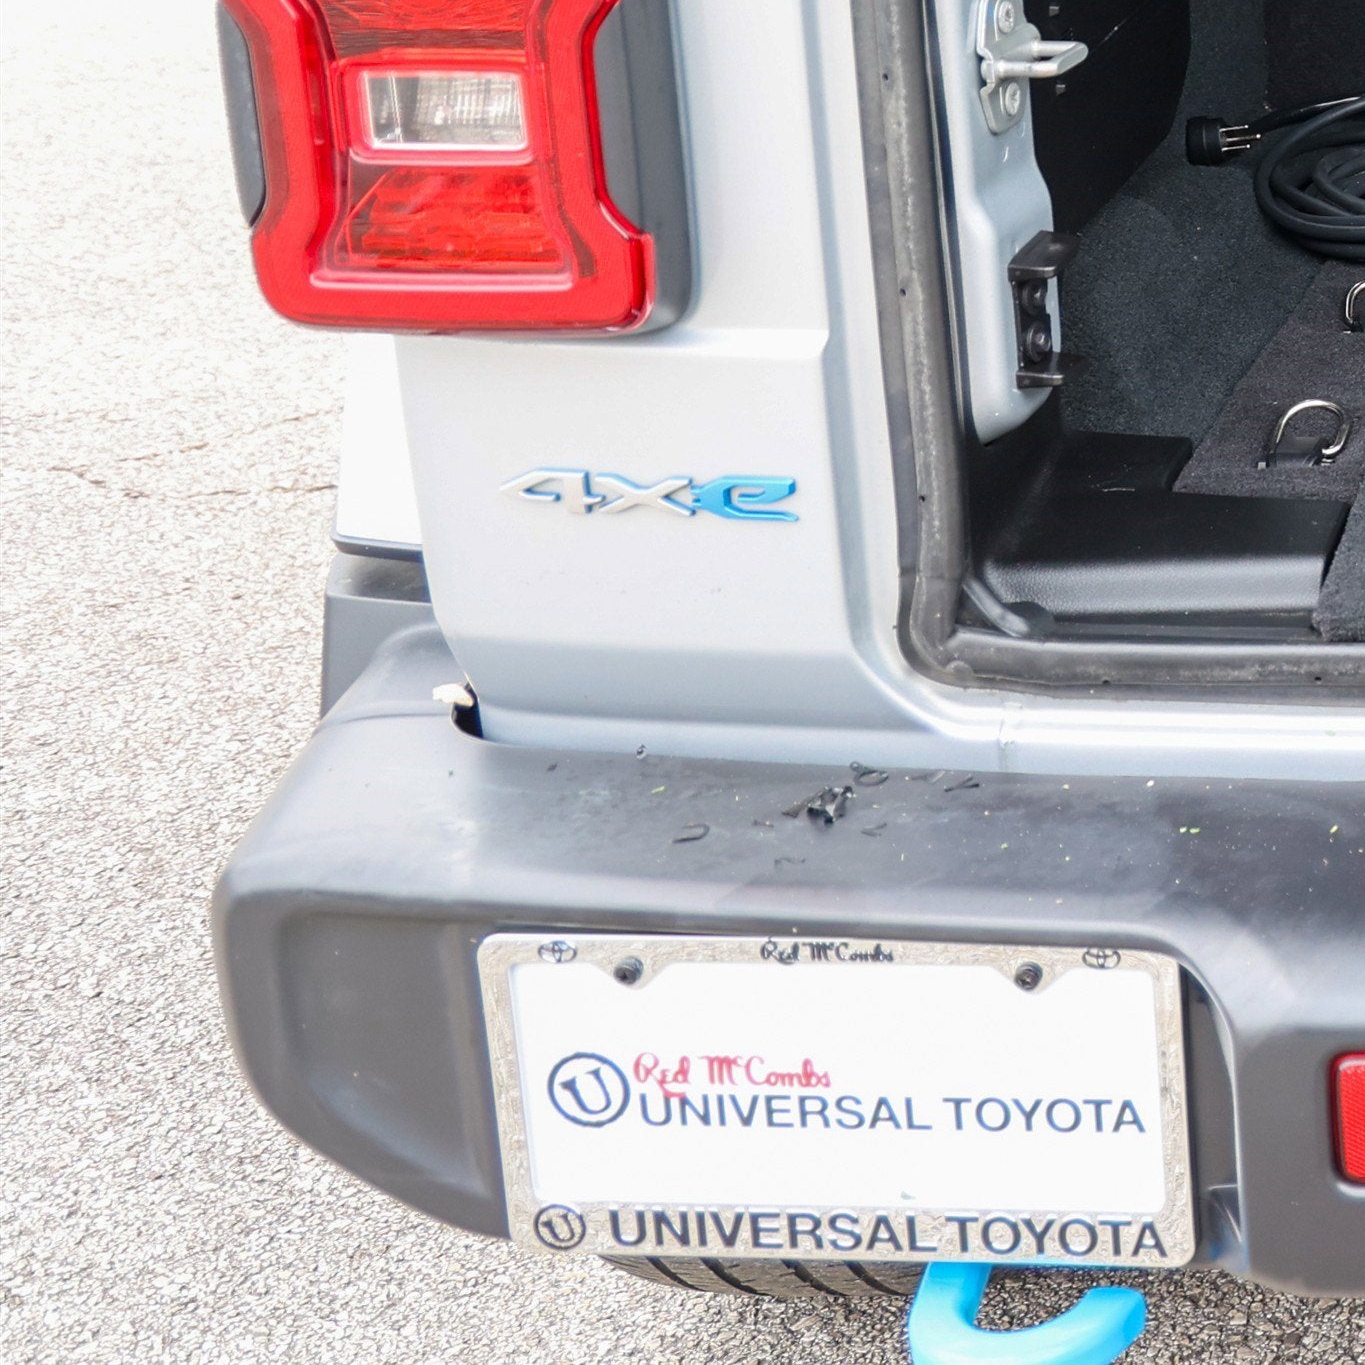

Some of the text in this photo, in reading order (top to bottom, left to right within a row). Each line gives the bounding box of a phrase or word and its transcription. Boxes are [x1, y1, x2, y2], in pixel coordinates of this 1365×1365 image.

[760, 936, 799, 965] Red
[633, 1052, 831, 1098] Red McCombs
[639, 1092, 1147, 1133] UNIVERSAL TOYOTA
[608, 1208, 1168, 1258] UNIVERSAL TOYOTA
